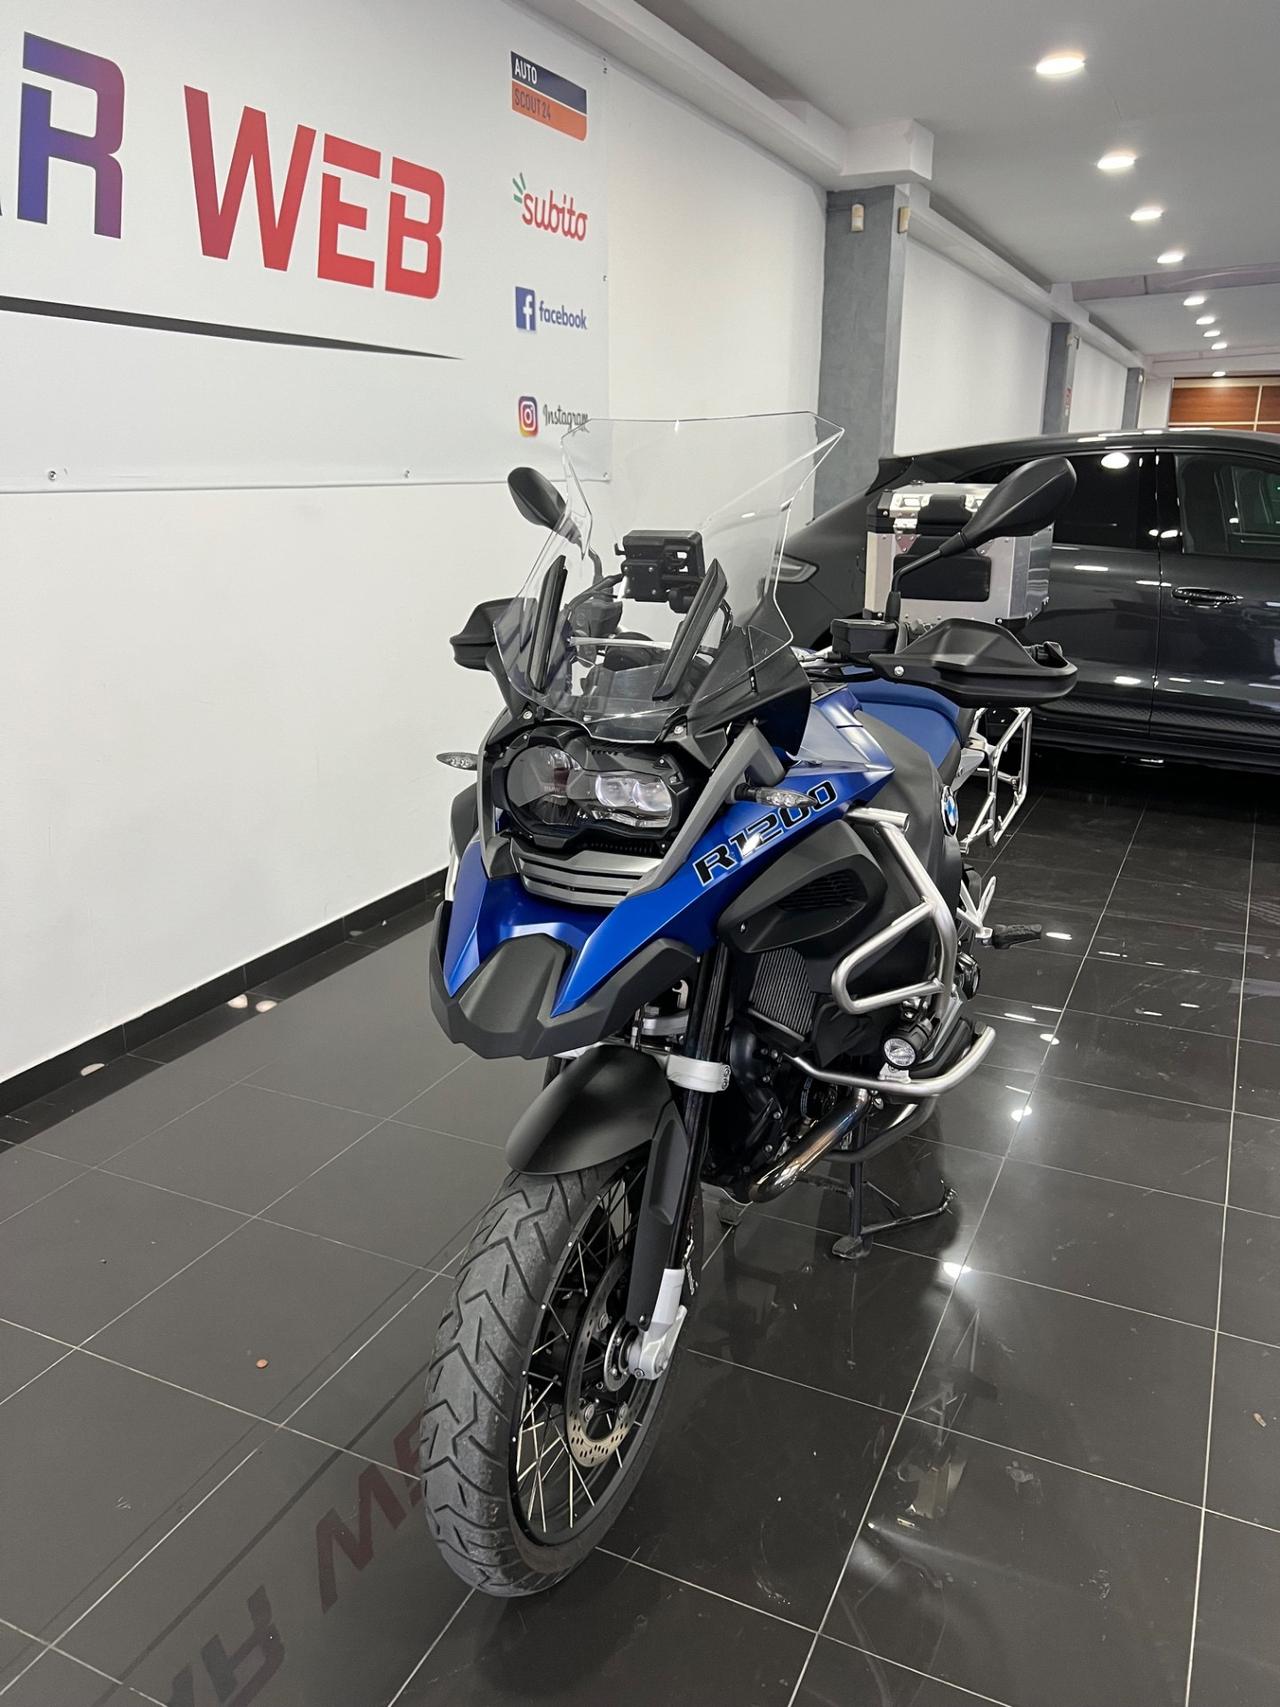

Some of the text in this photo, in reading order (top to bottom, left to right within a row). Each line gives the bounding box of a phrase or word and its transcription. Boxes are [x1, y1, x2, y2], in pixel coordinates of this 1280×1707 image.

[514, 58, 538, 86] AUTO
[0, 31, 445, 300] R WEB
[522, 189, 588, 241] subito
[539, 301, 588, 330] facebook
[543, 404, 589, 433] Instagram
[692, 779, 838, 888] R1200
